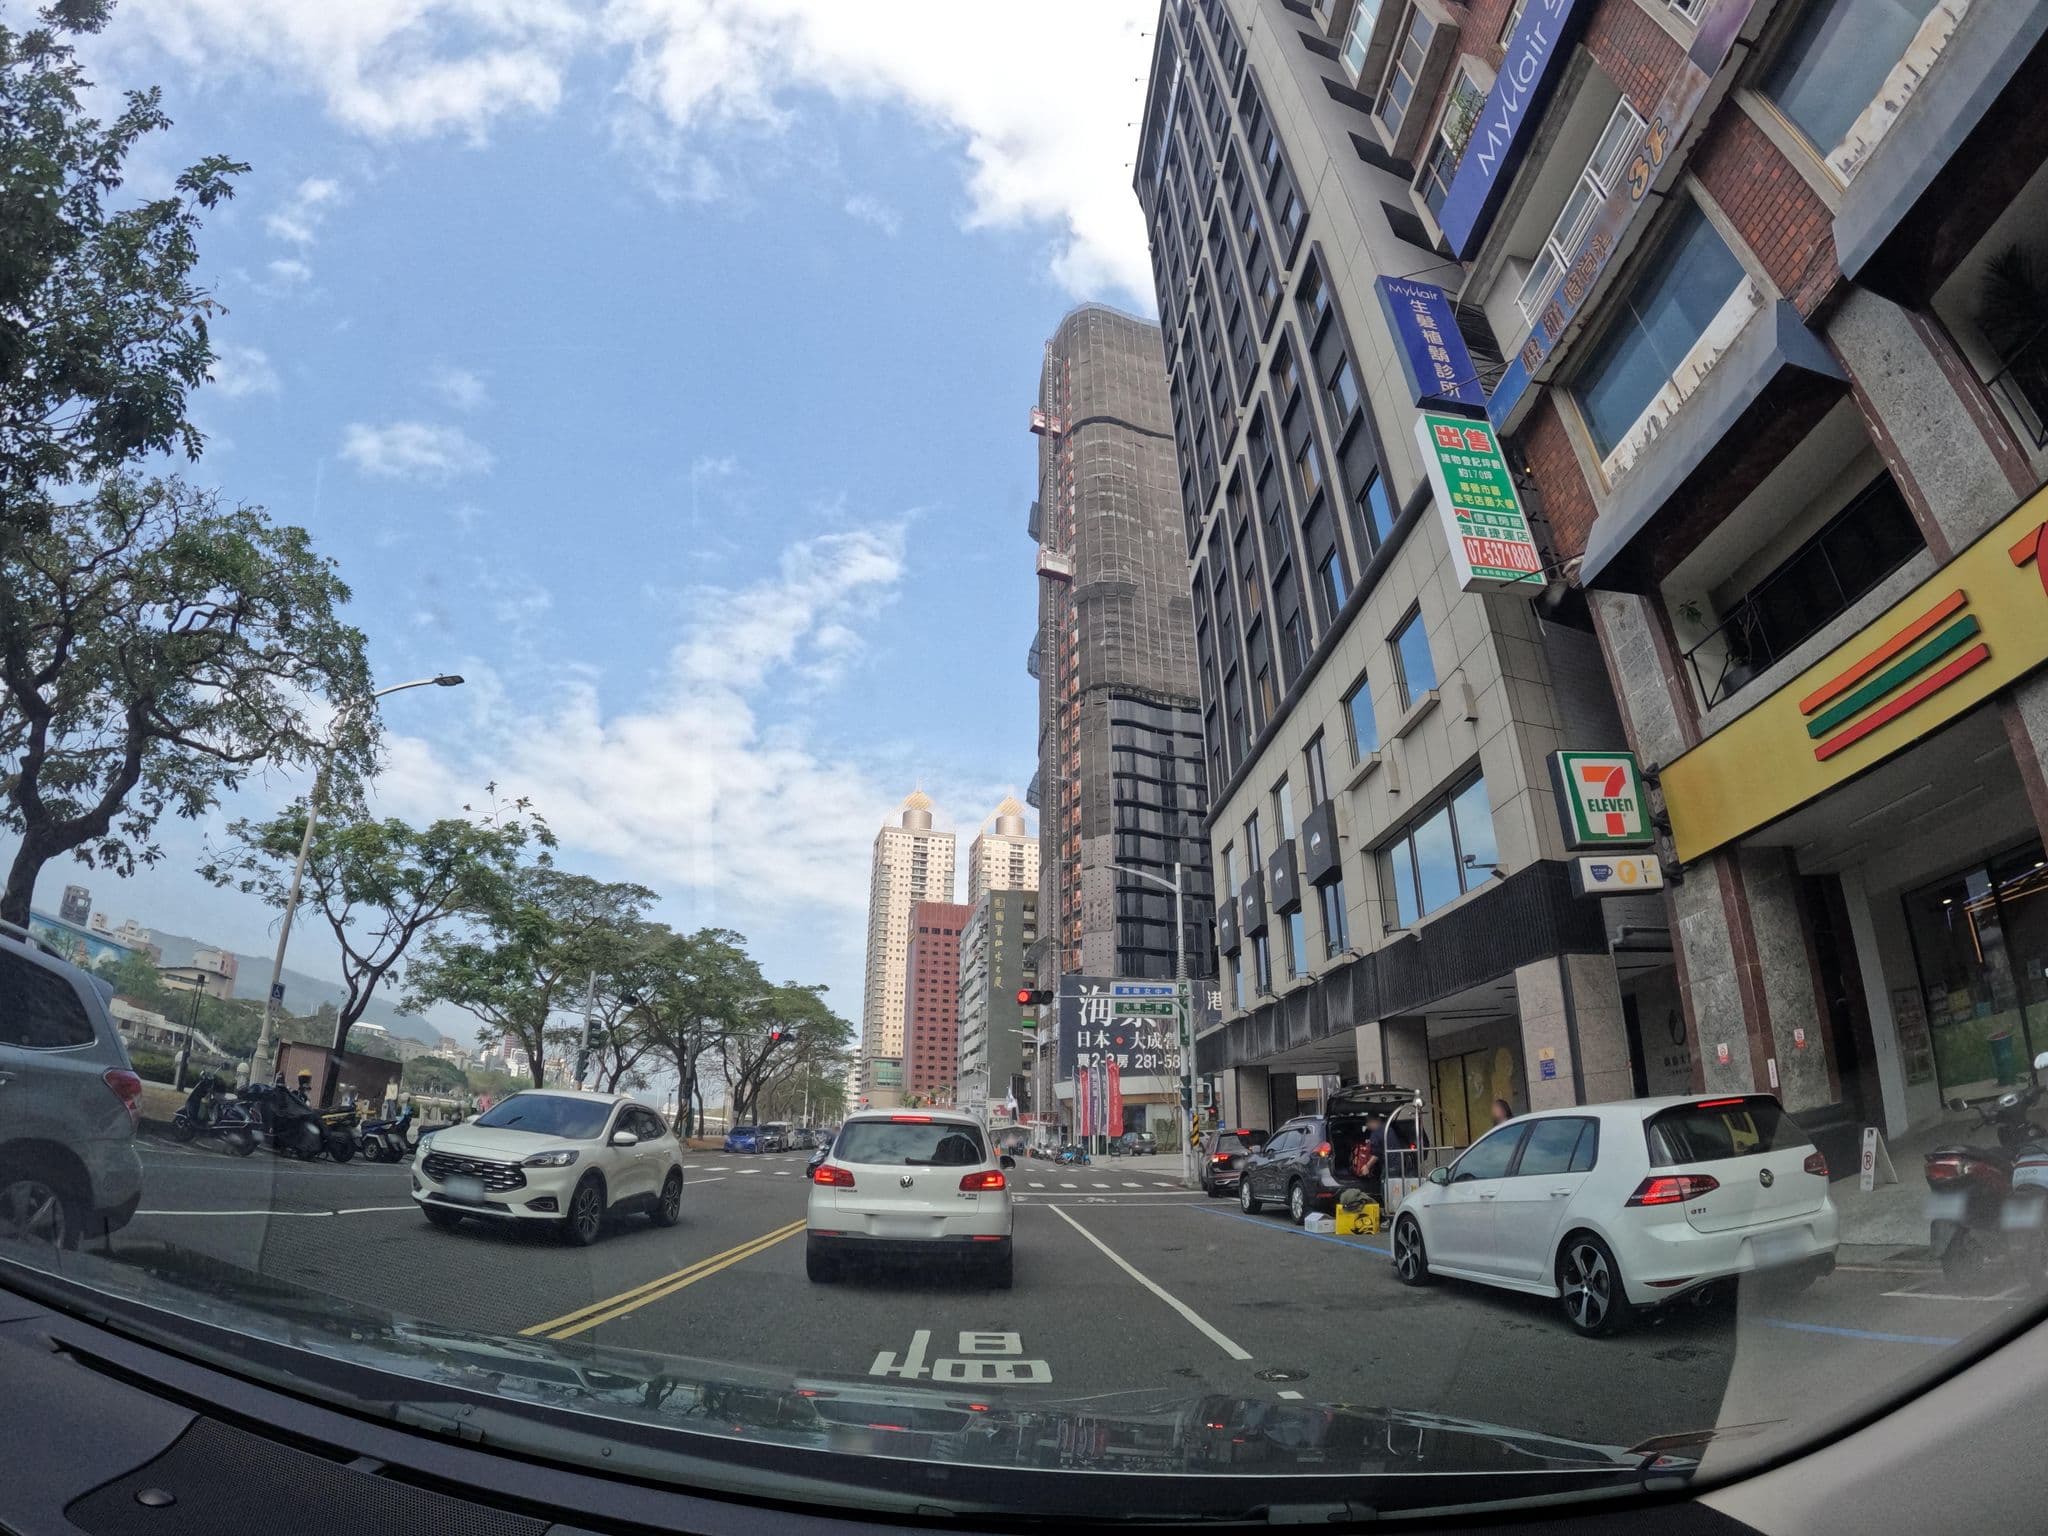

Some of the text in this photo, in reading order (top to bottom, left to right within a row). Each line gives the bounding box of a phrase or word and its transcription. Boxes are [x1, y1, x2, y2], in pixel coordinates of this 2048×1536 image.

[1627, 116, 1669, 201] 3F
[1433, 424, 1494, 454] 出售
[1581, 765, 1627, 836] 7
[1077, 1030, 1112, 1050] 日本
